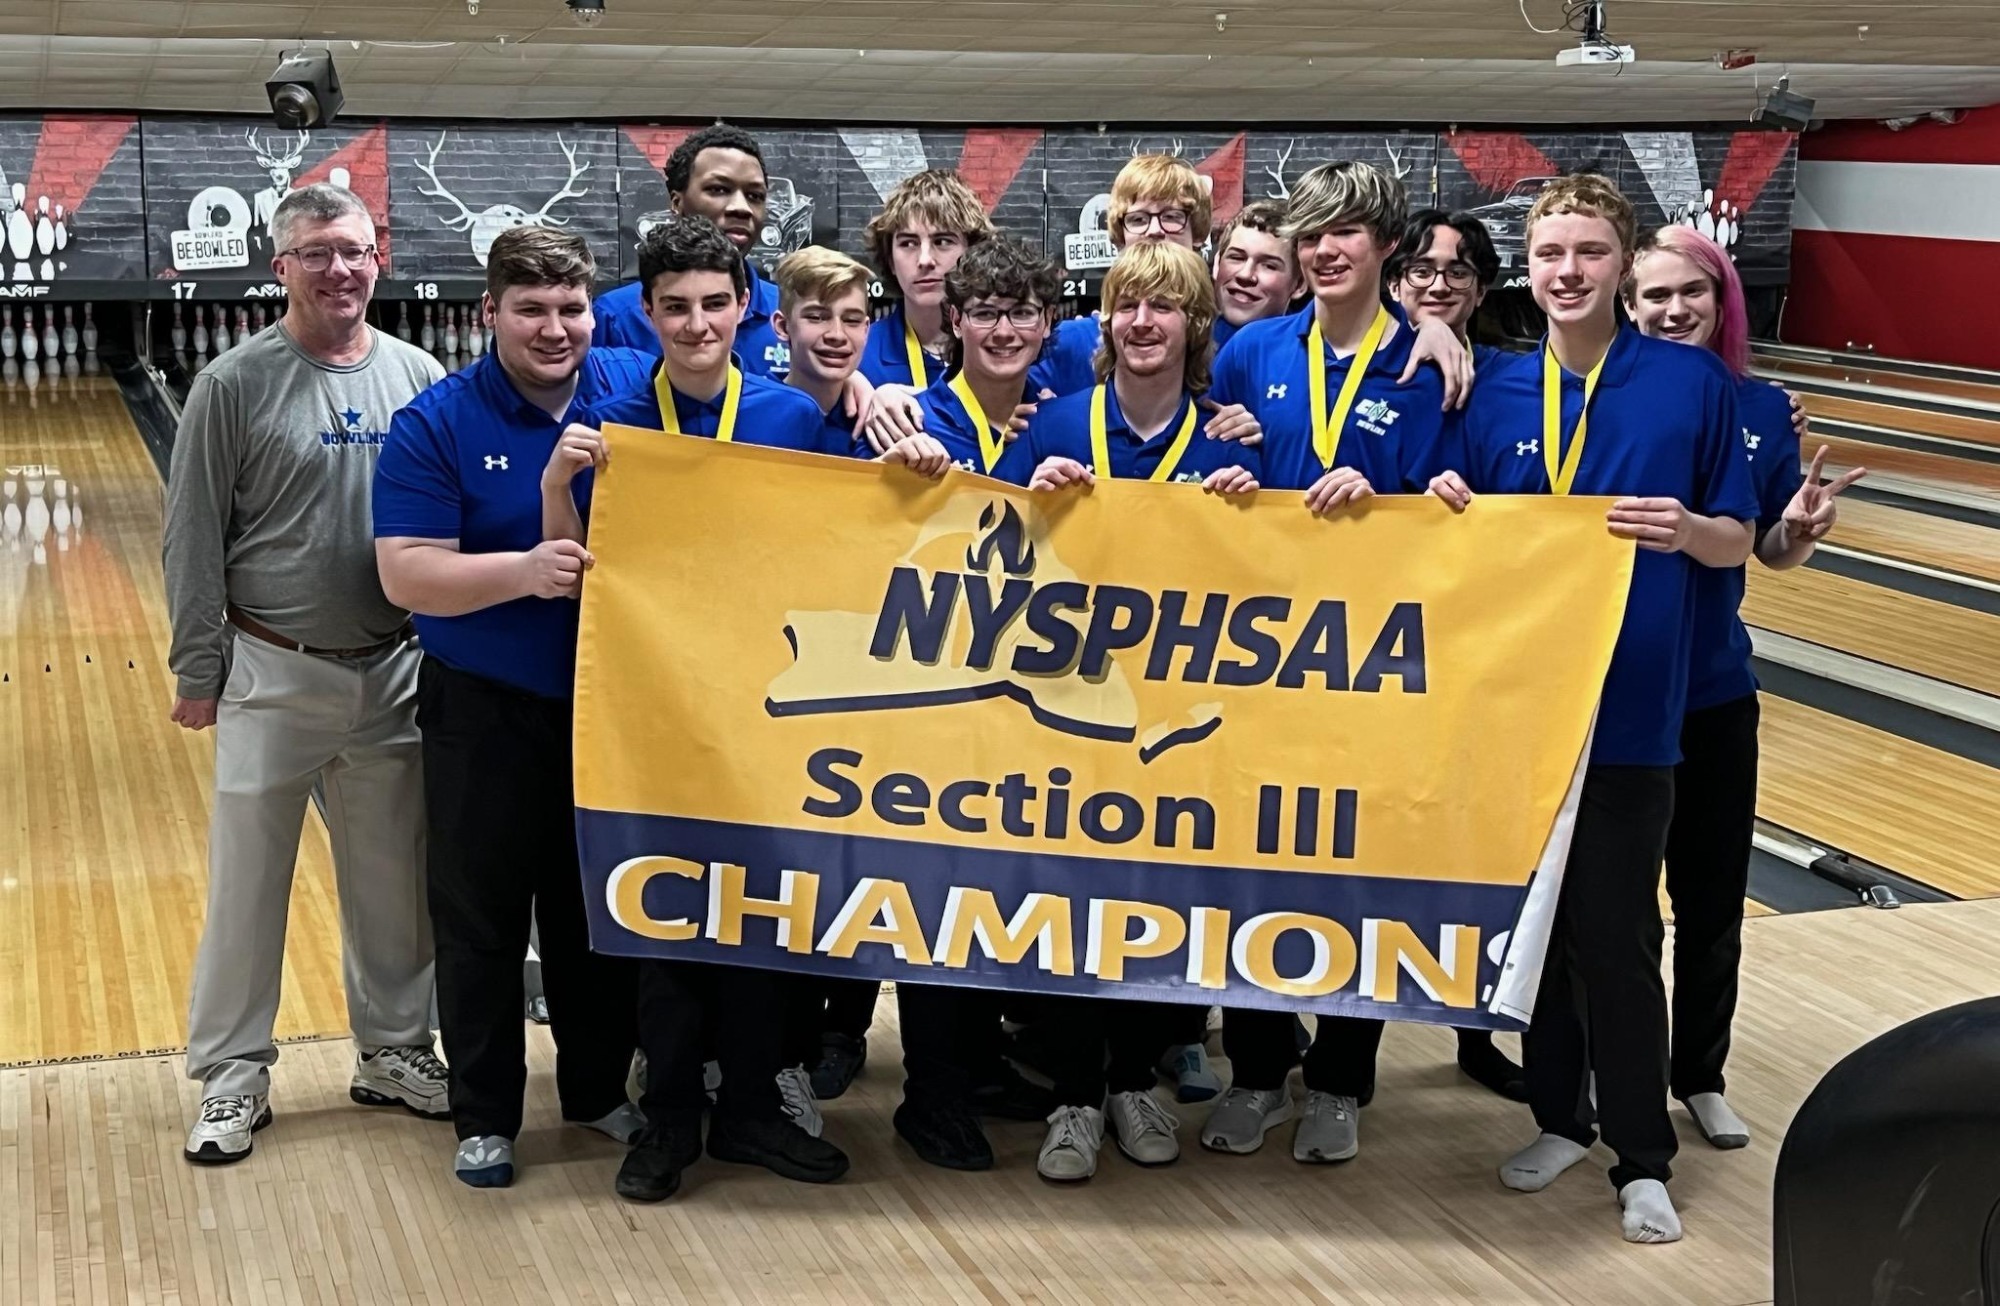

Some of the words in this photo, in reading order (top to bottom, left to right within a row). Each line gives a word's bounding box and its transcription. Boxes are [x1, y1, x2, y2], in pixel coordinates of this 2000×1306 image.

[1063, 279, 1086, 296] 21
[1503, 276, 1532, 288] AM
[0, 284, 50, 298] AMF
[171, 282, 197, 300] 17
[414, 282, 439, 300] 18
[869, 566, 1427, 694] NYSPHSAA
[802, 747, 1216, 850] Section
[1256, 785, 1358, 858] III
[146, 1047, 177, 1055] NOT
